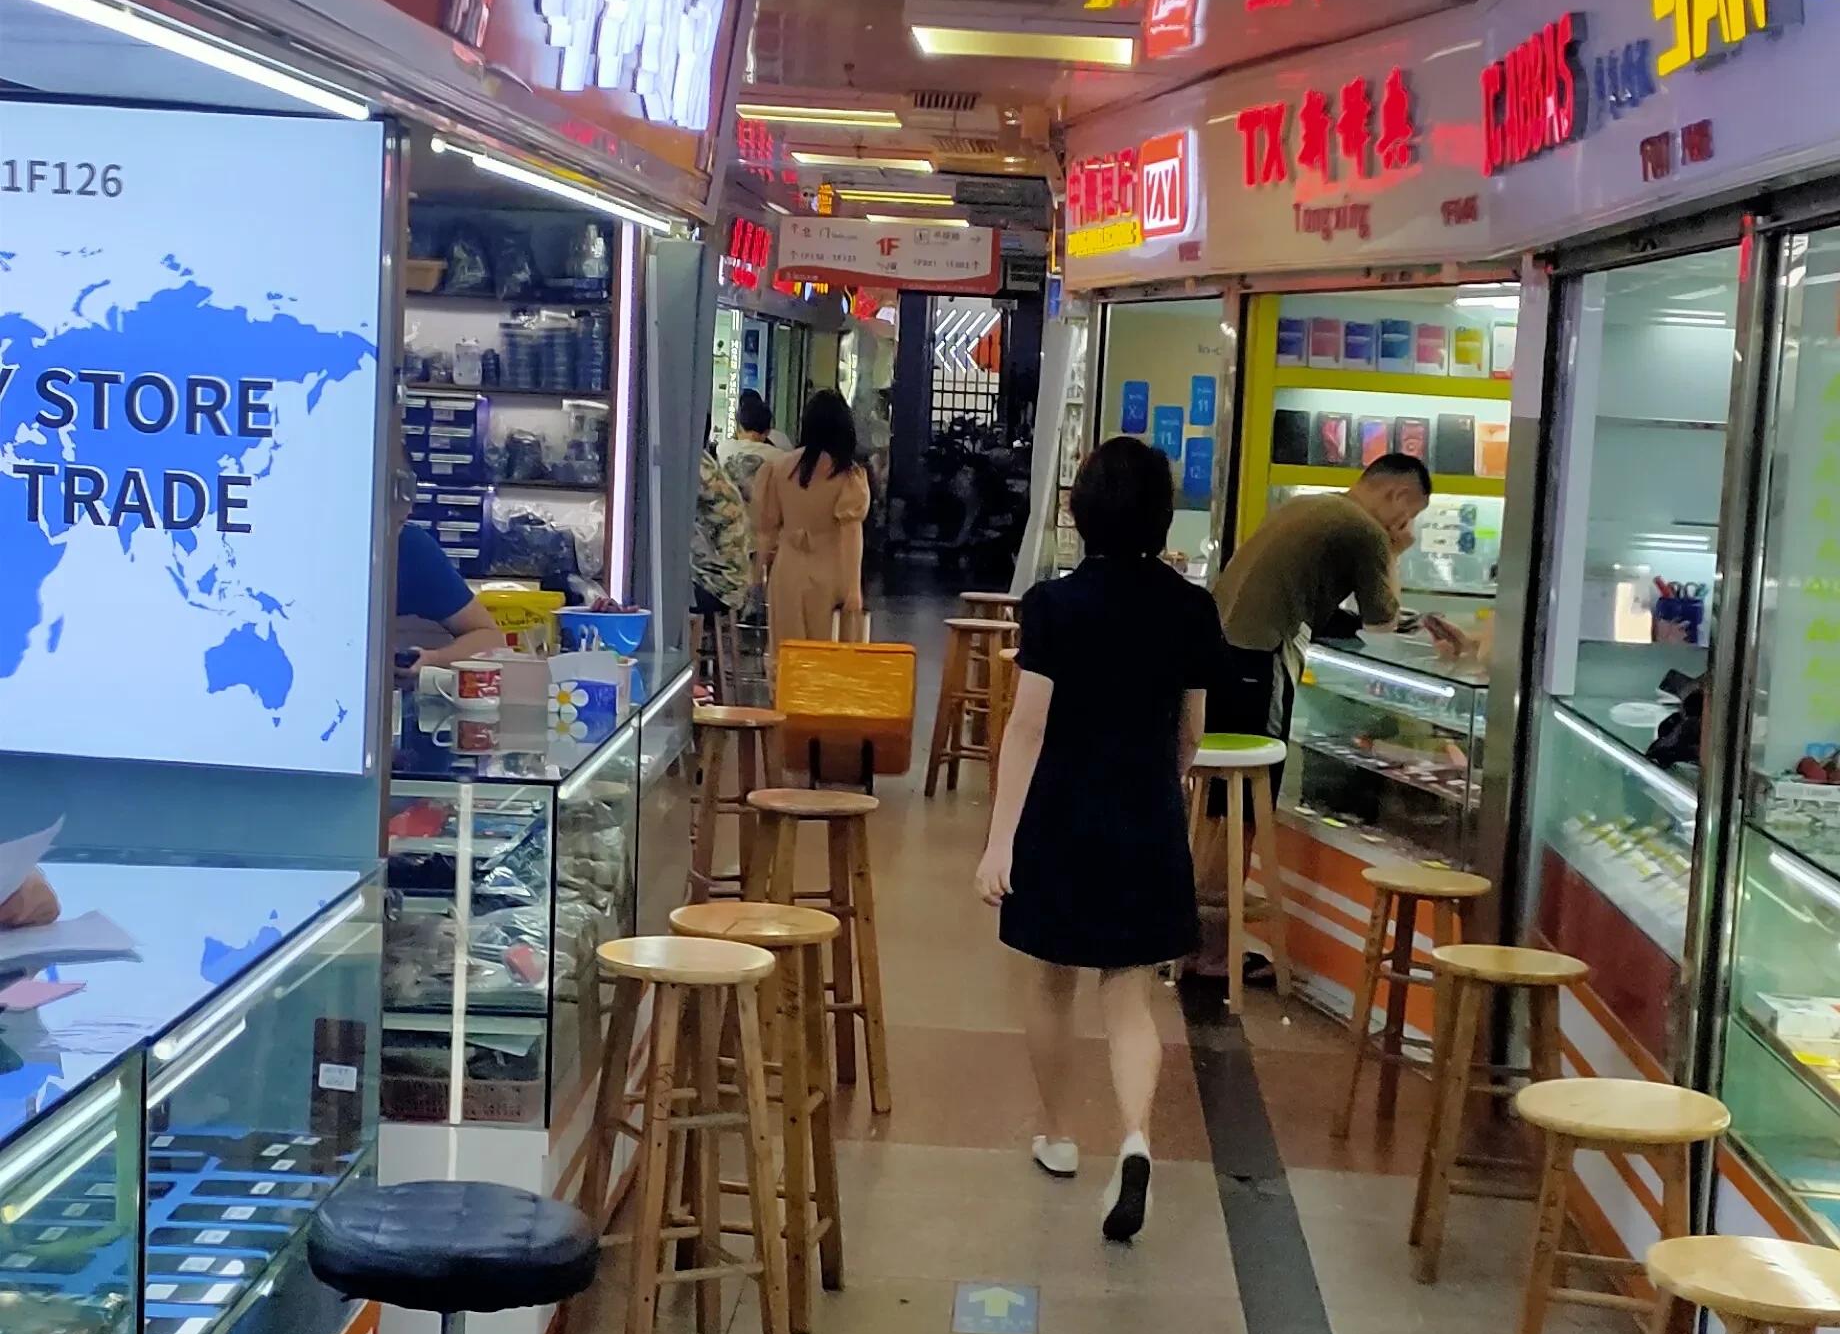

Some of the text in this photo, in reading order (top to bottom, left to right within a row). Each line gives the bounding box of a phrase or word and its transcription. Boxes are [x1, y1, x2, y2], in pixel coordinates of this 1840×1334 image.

[0, 159, 124, 197] 1F126
[1236, 103, 1288, 187] TX
[35, 367, 276, 439] STORE
[12, 463, 254, 534] TRADE
